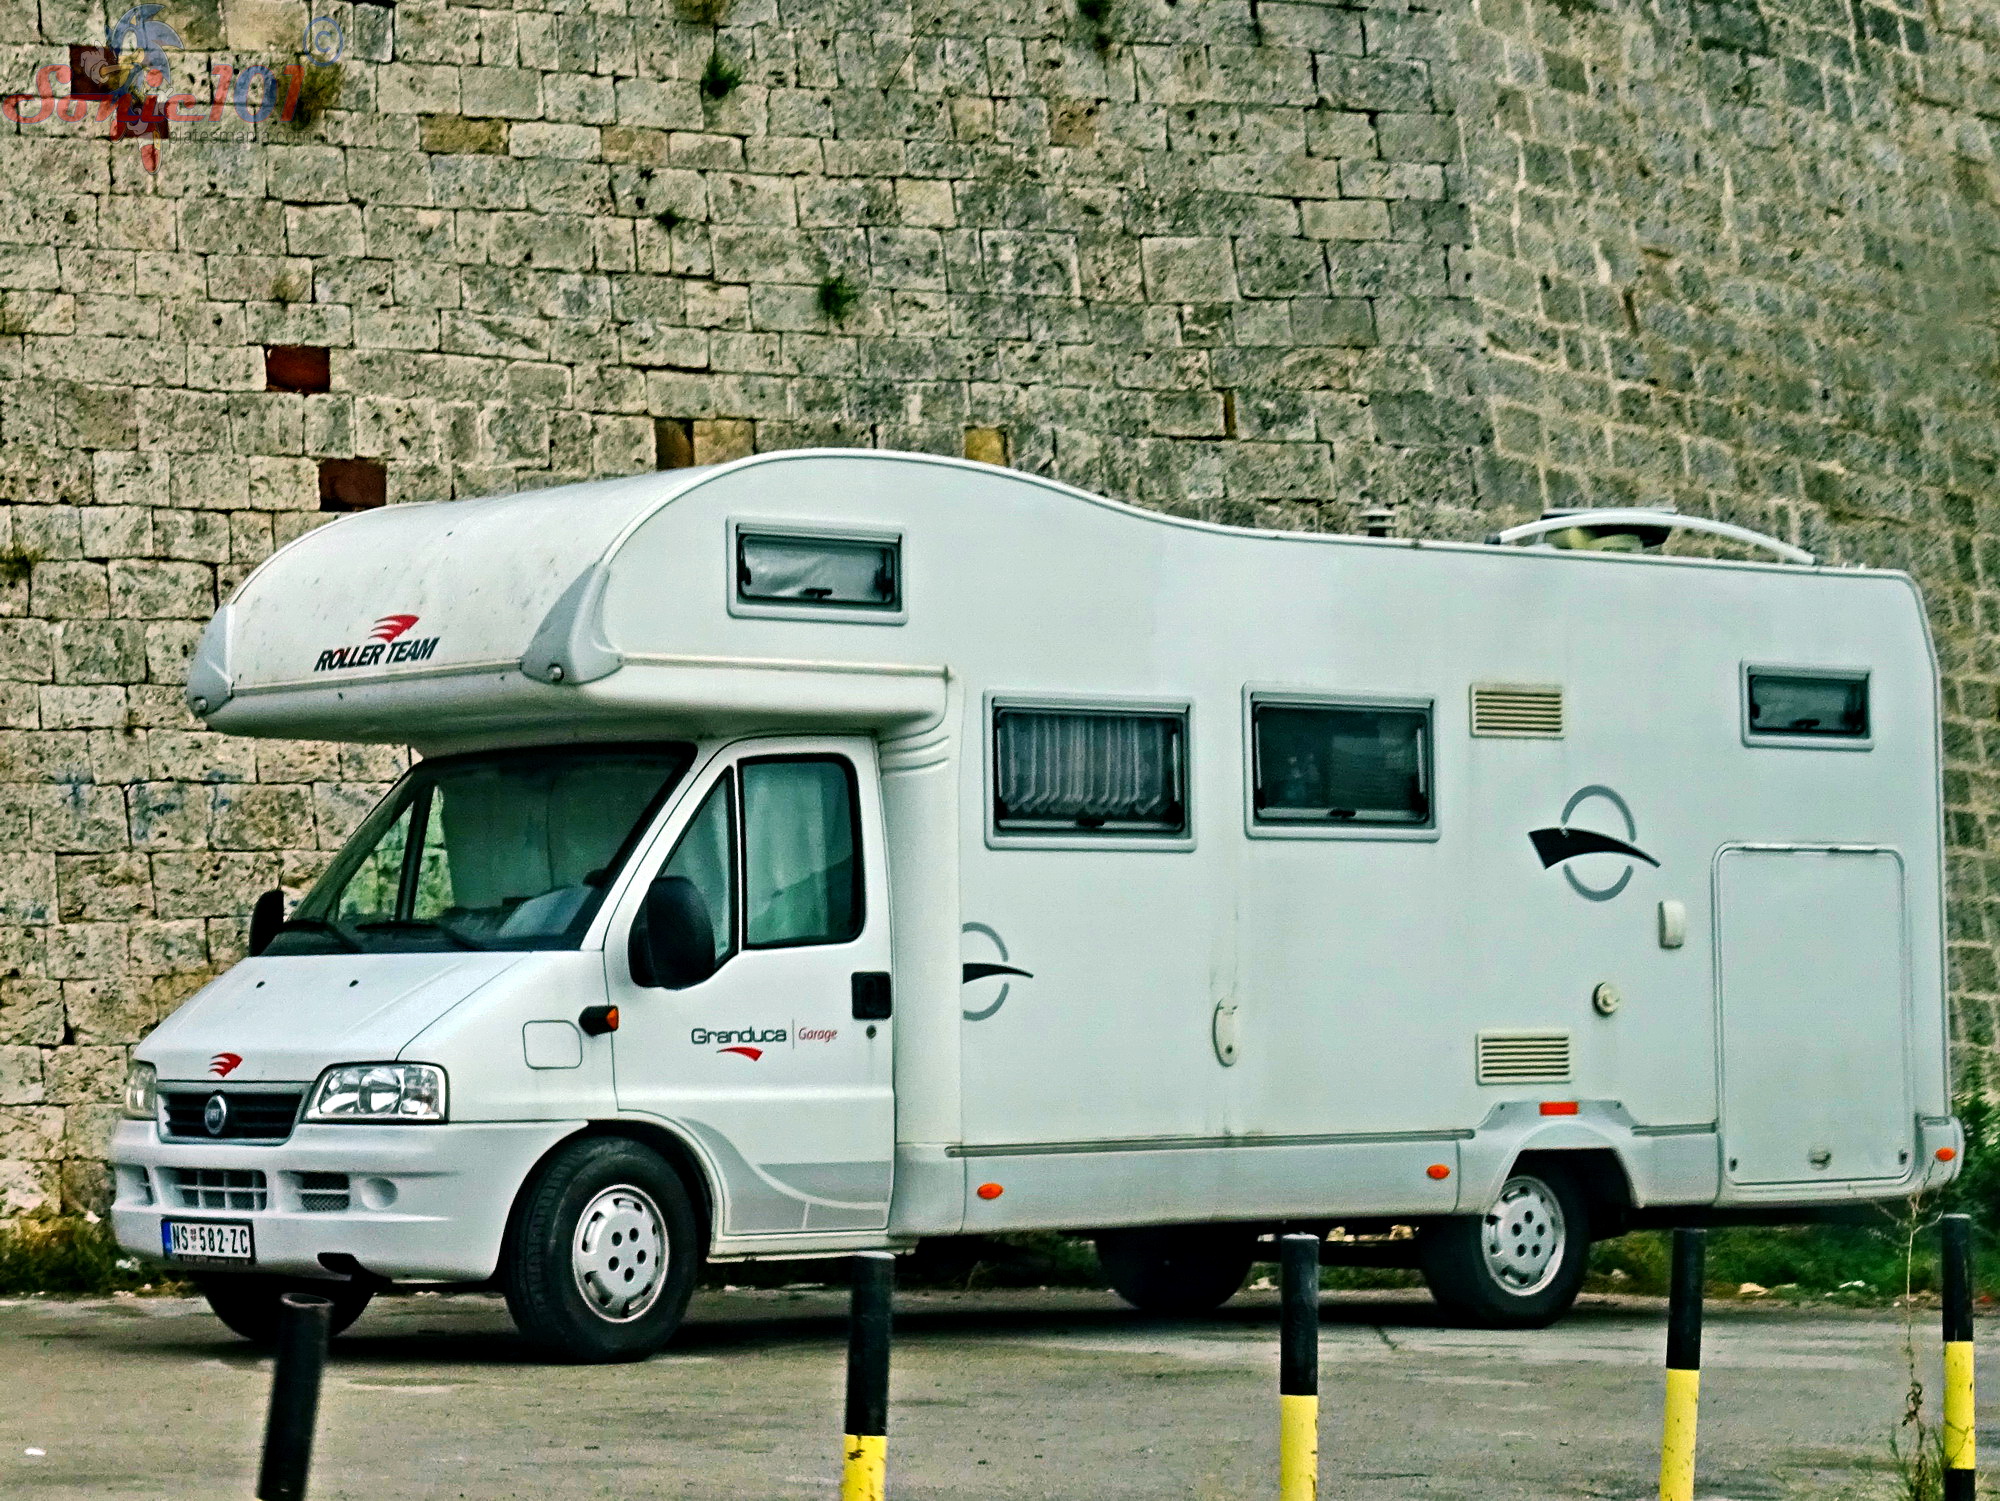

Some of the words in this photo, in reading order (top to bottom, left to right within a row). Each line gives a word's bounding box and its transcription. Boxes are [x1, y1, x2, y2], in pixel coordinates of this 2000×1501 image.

[314, 644, 386, 672] ROLLER
[386, 637, 440, 664] TEAM
[691, 1025, 787, 1044] Granduca
[798, 1027, 838, 1043] Garage
